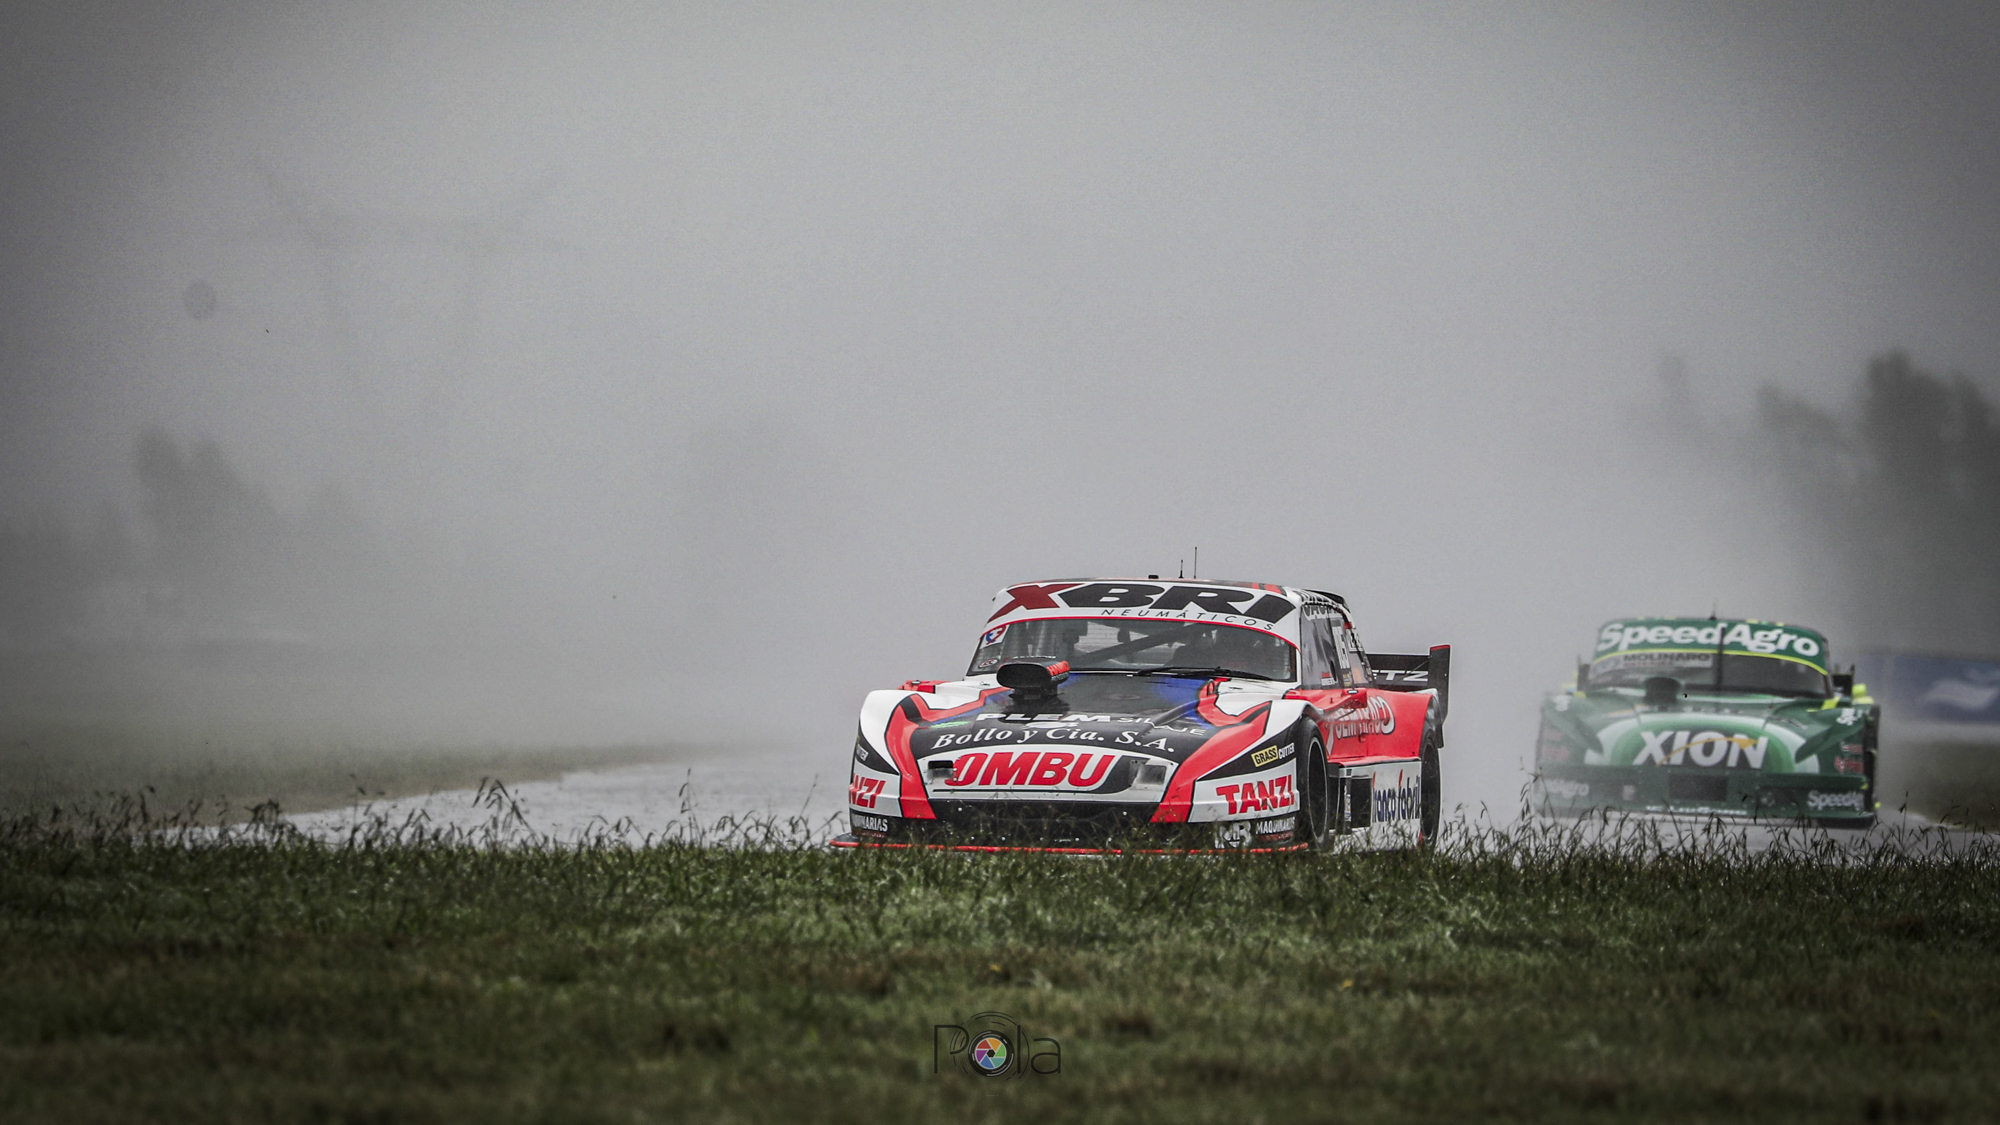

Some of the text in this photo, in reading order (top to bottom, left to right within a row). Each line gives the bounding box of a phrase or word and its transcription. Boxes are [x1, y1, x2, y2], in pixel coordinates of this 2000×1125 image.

[987, 582, 1297, 624] XBRI
[1101, 608, 1275, 631] NEUMÁTICOS
[1597, 623, 1820, 657] SpeedAgro
[976, 713, 1111, 722] PLEM
[930, 727, 1175, 753] Bollo y Cia. S.A.
[1253, 747, 1277, 765] GRASS
[1633, 730, 1769, 769] XION
[944, 751, 1116, 787] OMBU
[1215, 774, 1296, 815] TANZI
